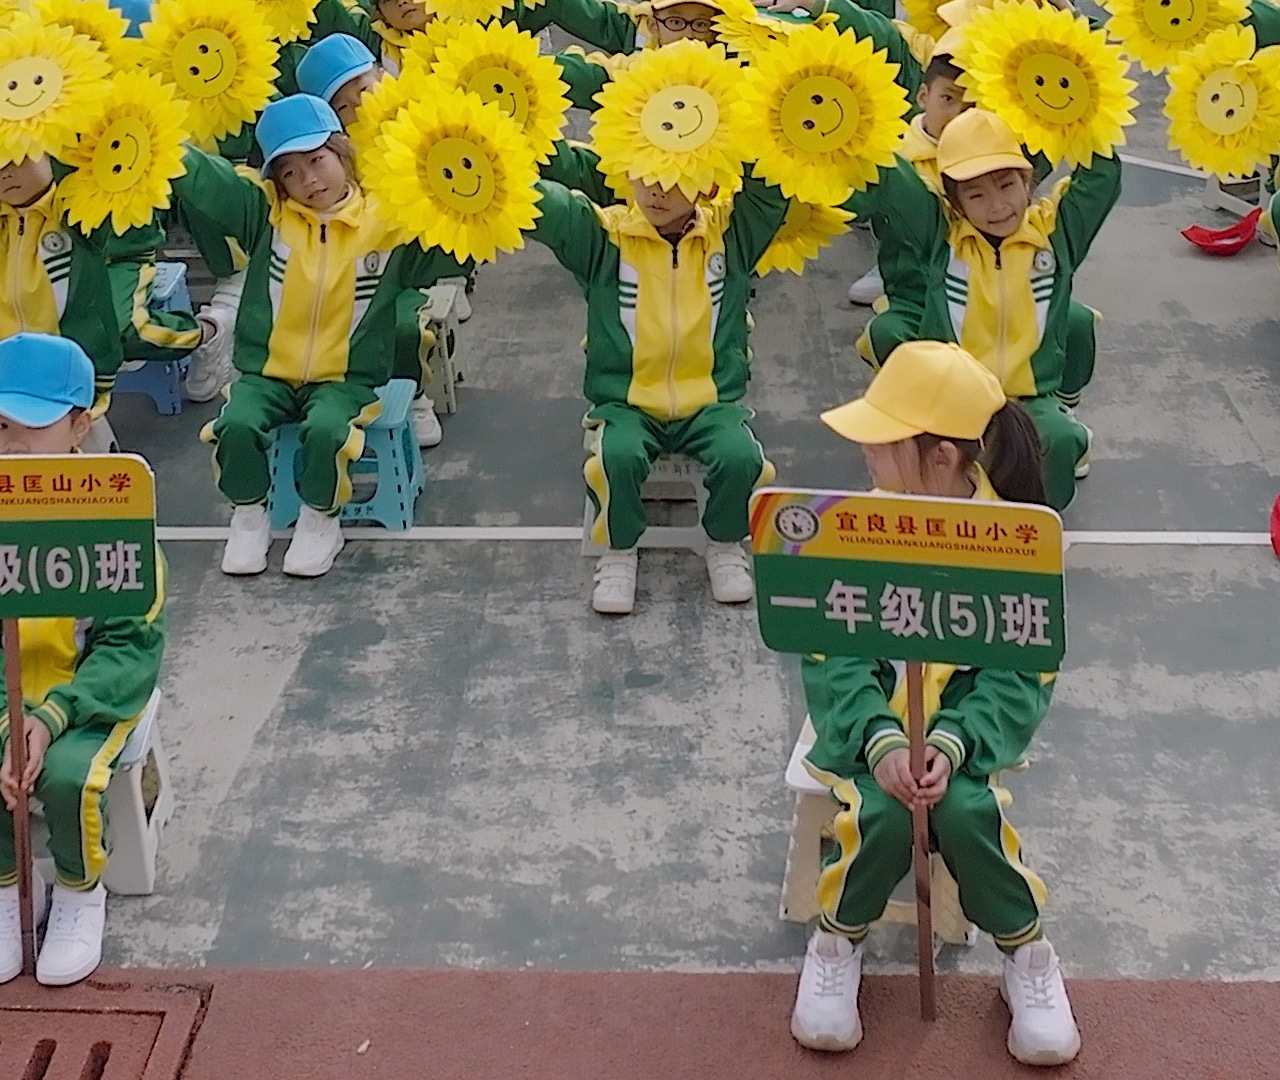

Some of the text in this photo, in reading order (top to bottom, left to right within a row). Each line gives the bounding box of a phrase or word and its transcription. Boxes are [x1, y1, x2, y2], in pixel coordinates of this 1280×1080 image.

[835, 511, 1039, 545] 宜良县匡山小学
[839, 535, 1038, 557] YILIANGXIANKUANGSHANXIAOXUE
[770, 578, 1052, 647] 一年级(5)班
